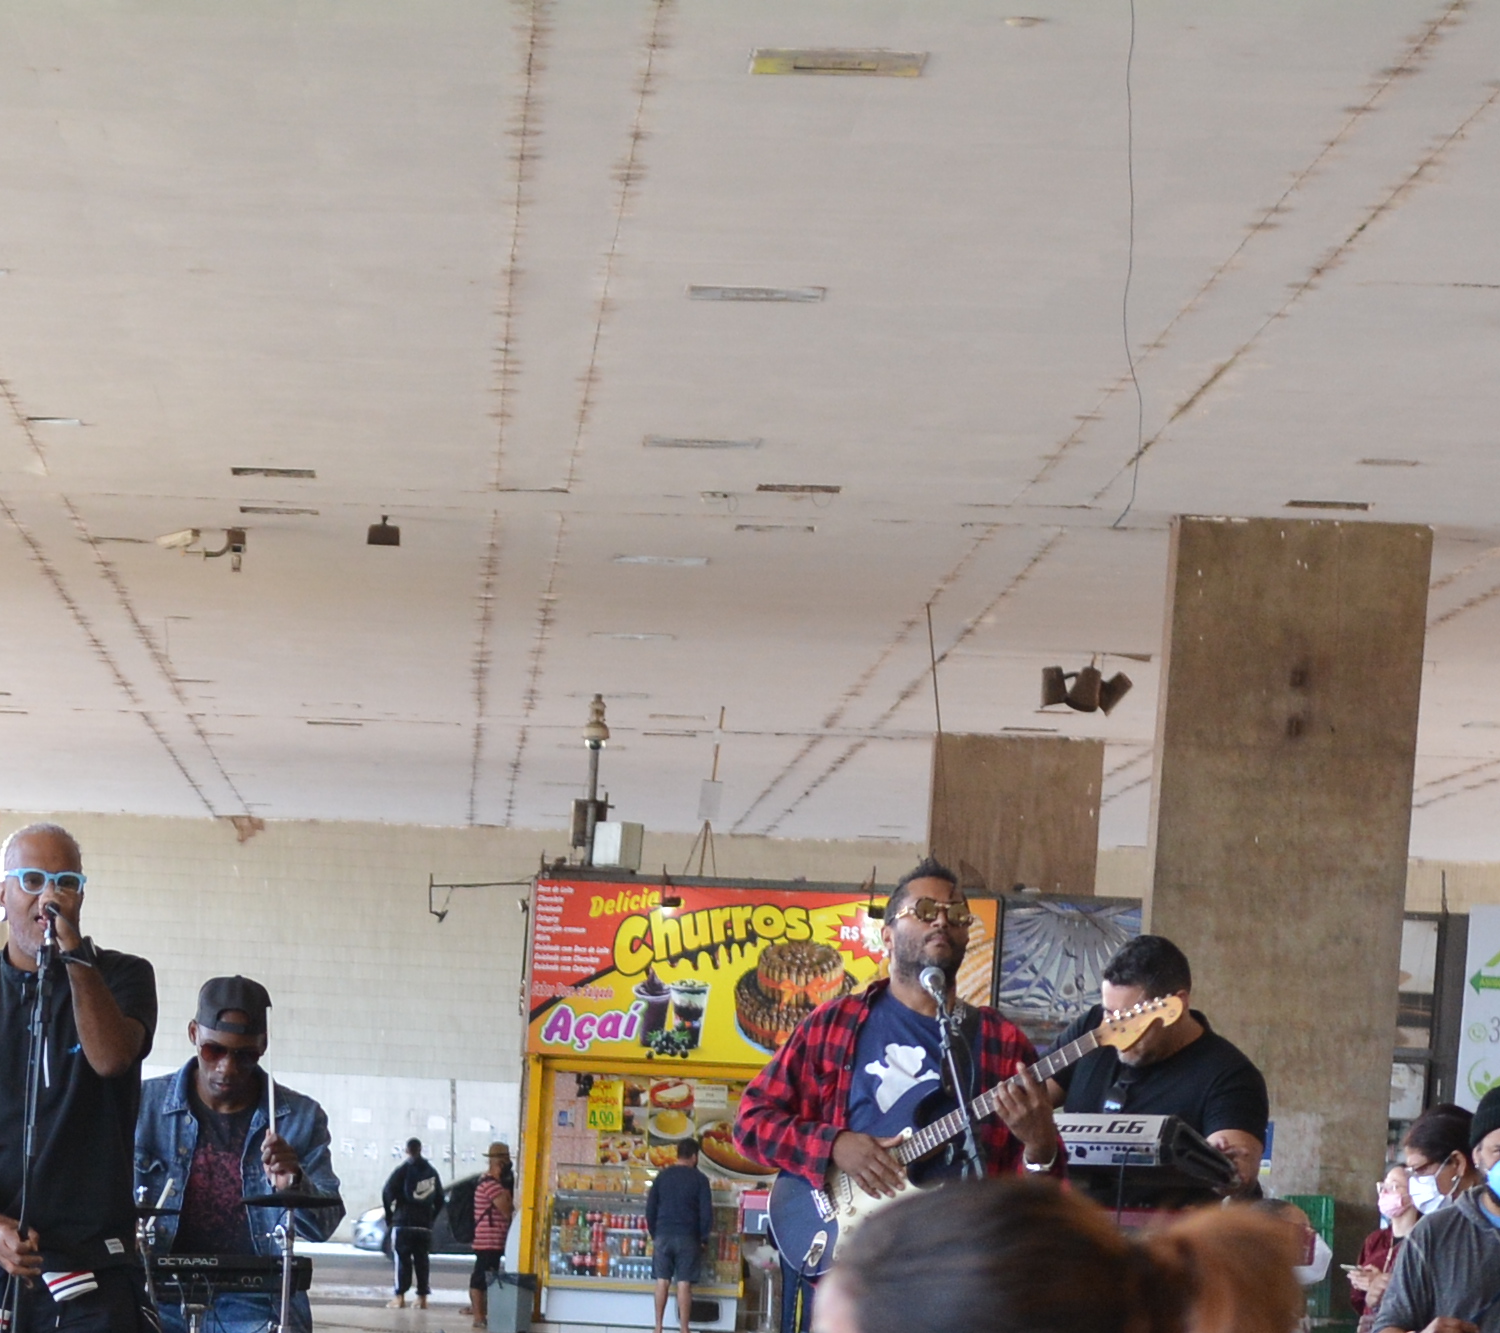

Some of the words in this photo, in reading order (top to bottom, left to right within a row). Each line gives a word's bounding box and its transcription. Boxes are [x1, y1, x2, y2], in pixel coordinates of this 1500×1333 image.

[613, 904, 815, 977] Churros
[542, 1001, 646, 1051] Açaí
[1106, 1119, 1147, 1135] G6
[157, 1257, 219, 1267] OCTAPAD
